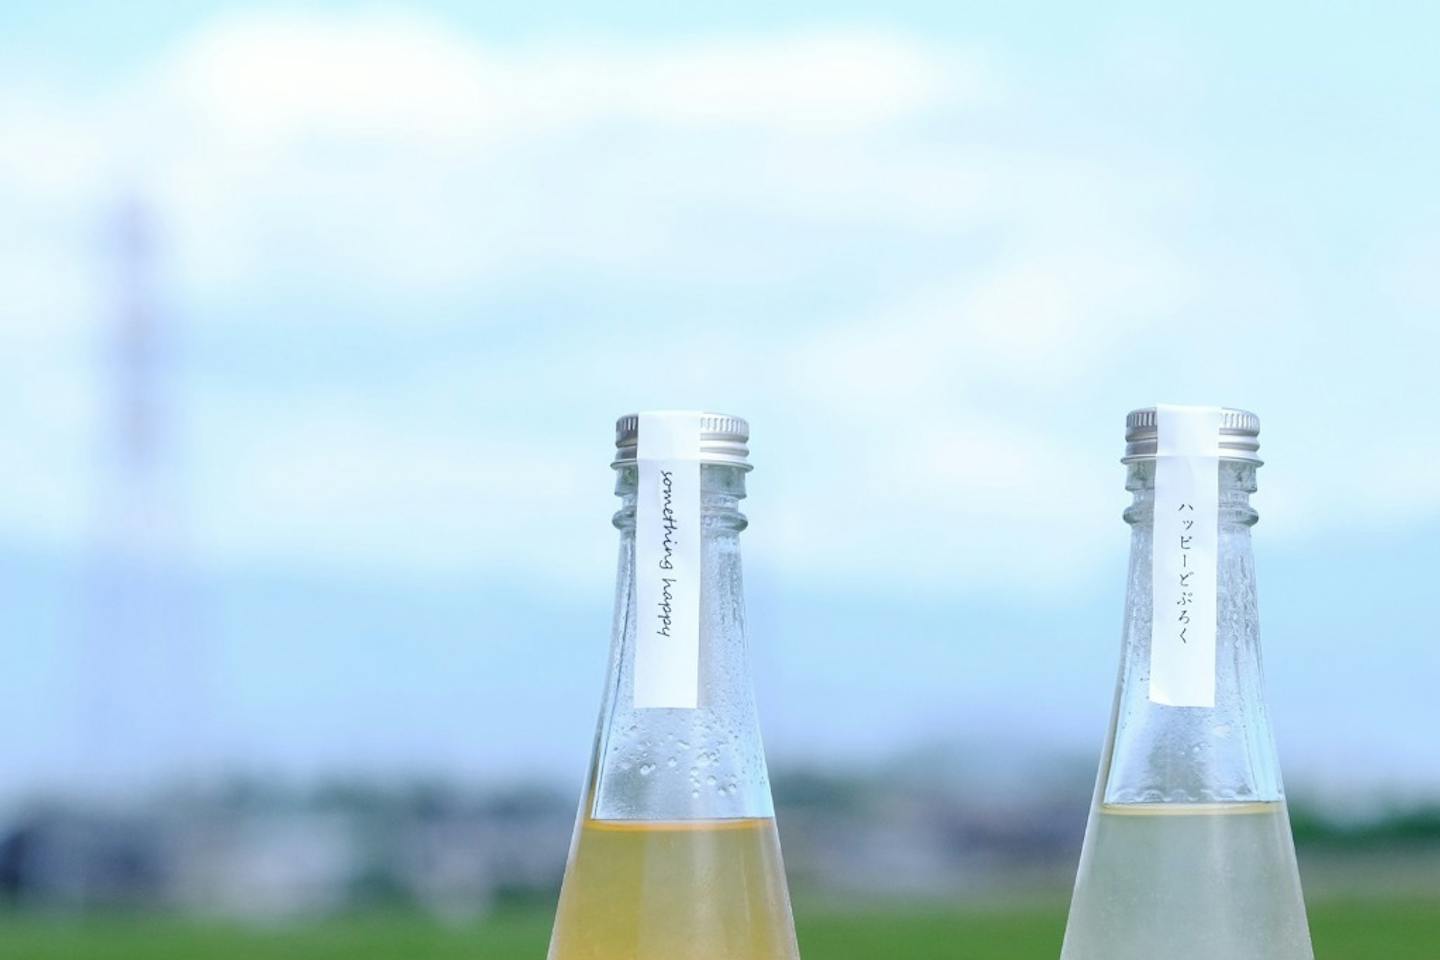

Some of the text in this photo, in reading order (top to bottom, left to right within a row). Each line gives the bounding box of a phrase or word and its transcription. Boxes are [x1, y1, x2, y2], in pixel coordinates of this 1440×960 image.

[656, 469, 679, 638] something happy
[1176, 503, 1195, 644] ハッピーどぶろく
